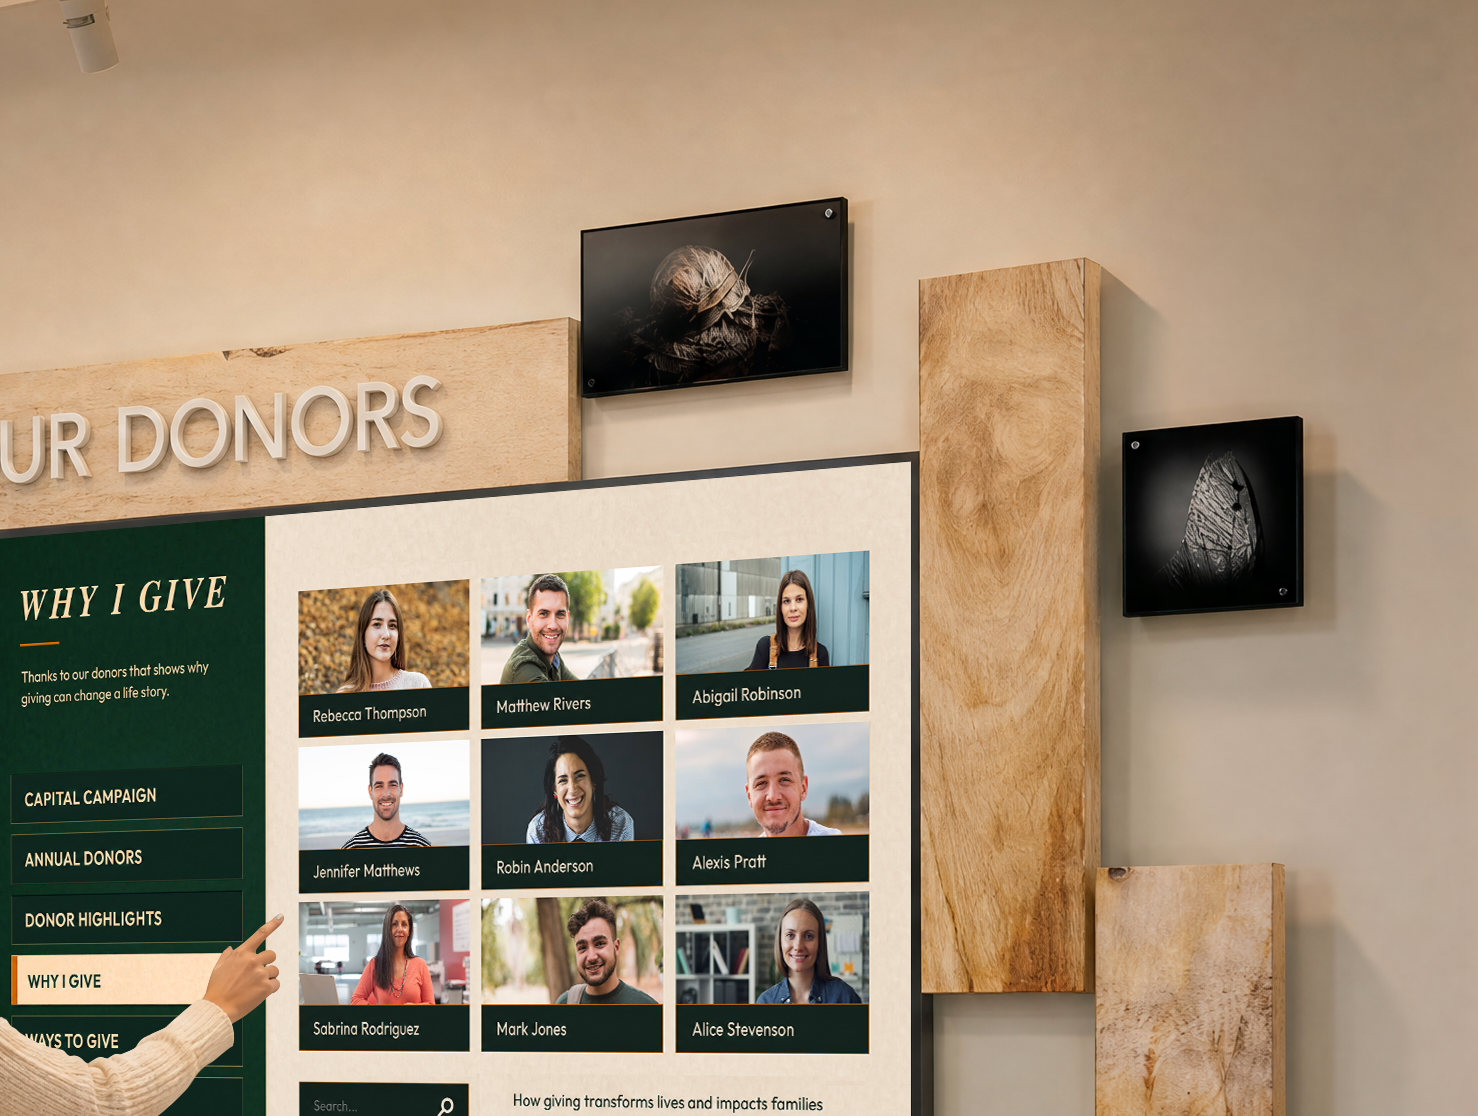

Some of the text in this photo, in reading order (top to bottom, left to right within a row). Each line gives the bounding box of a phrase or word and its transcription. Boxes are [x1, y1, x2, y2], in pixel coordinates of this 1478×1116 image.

[117, 374, 444, 474] DONORS
[20, 575, 227, 621] WHY I GIVE
[21, 660, 209, 684] Thanks to our donors that shows why
[21, 685, 170, 708] giving can change a life story.
[496, 697, 591, 714] Matthew Rivers
[692, 686, 801, 707] Abigail Robinson
[313, 705, 427, 723] Rebecca Thompson
[24, 787, 157, 807] CAPITAL CAMPAIGN
[24, 849, 143, 868] ANNUAL DONORS
[496, 859, 594, 875] Robin Anderson
[692, 854, 767, 870] Alexis Pratt
[313, 863, 421, 879] Jennifer Matthews
[25, 910, 162, 928] DONOR HIGHLIGHTS
[27, 973, 102, 989] WHY I GIVE
[313, 1021, 420, 1040] Sabrina Rodriguez
[496, 1021, 567, 1037] Mark Jones
[692, 1021, 795, 1037] Alice Stevenson
[64, 1033, 84, 1049] TO
[86, 1033, 119, 1049] GIVE
[513, 1093, 824, 1114] How giving transforms lives and impacts families
